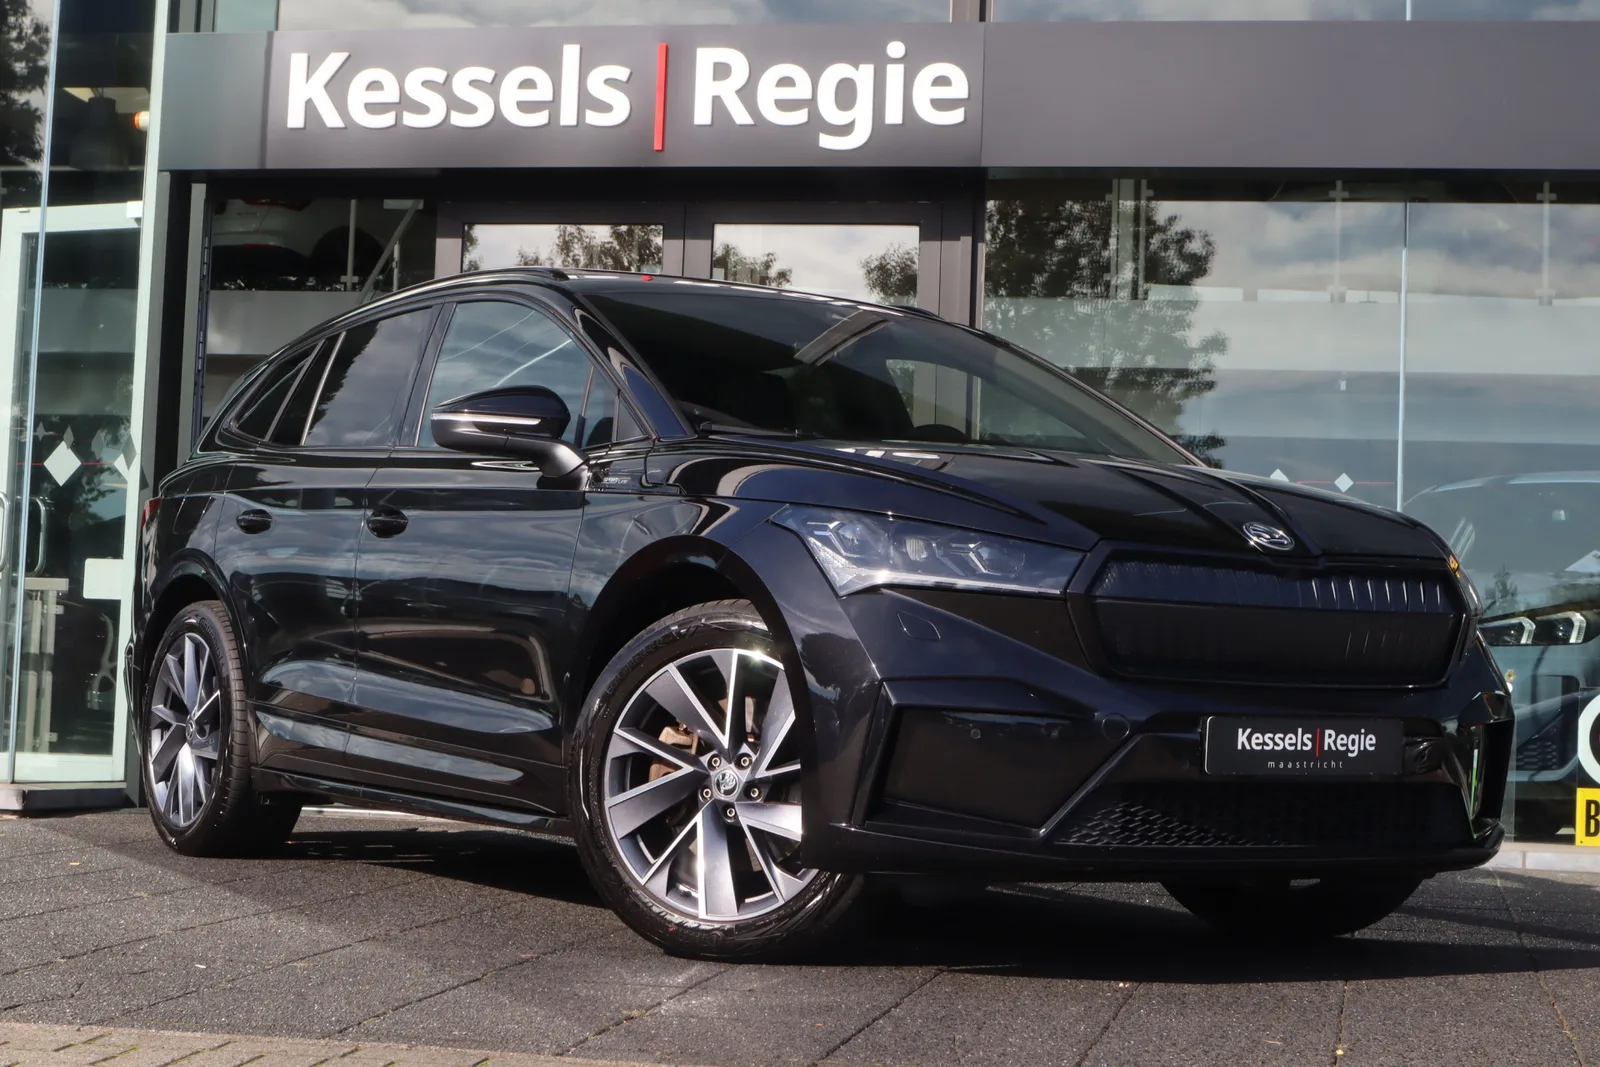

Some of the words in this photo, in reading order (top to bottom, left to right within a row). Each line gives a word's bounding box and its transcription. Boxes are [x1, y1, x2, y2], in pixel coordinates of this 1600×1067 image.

[286, 43, 631, 129] Kessels
[692, 40, 970, 151] Regie
[1237, 727, 1313, 751] Kessels
[1323, 728, 1377, 758] Regie
[1267, 759, 1343, 769] maastricht
